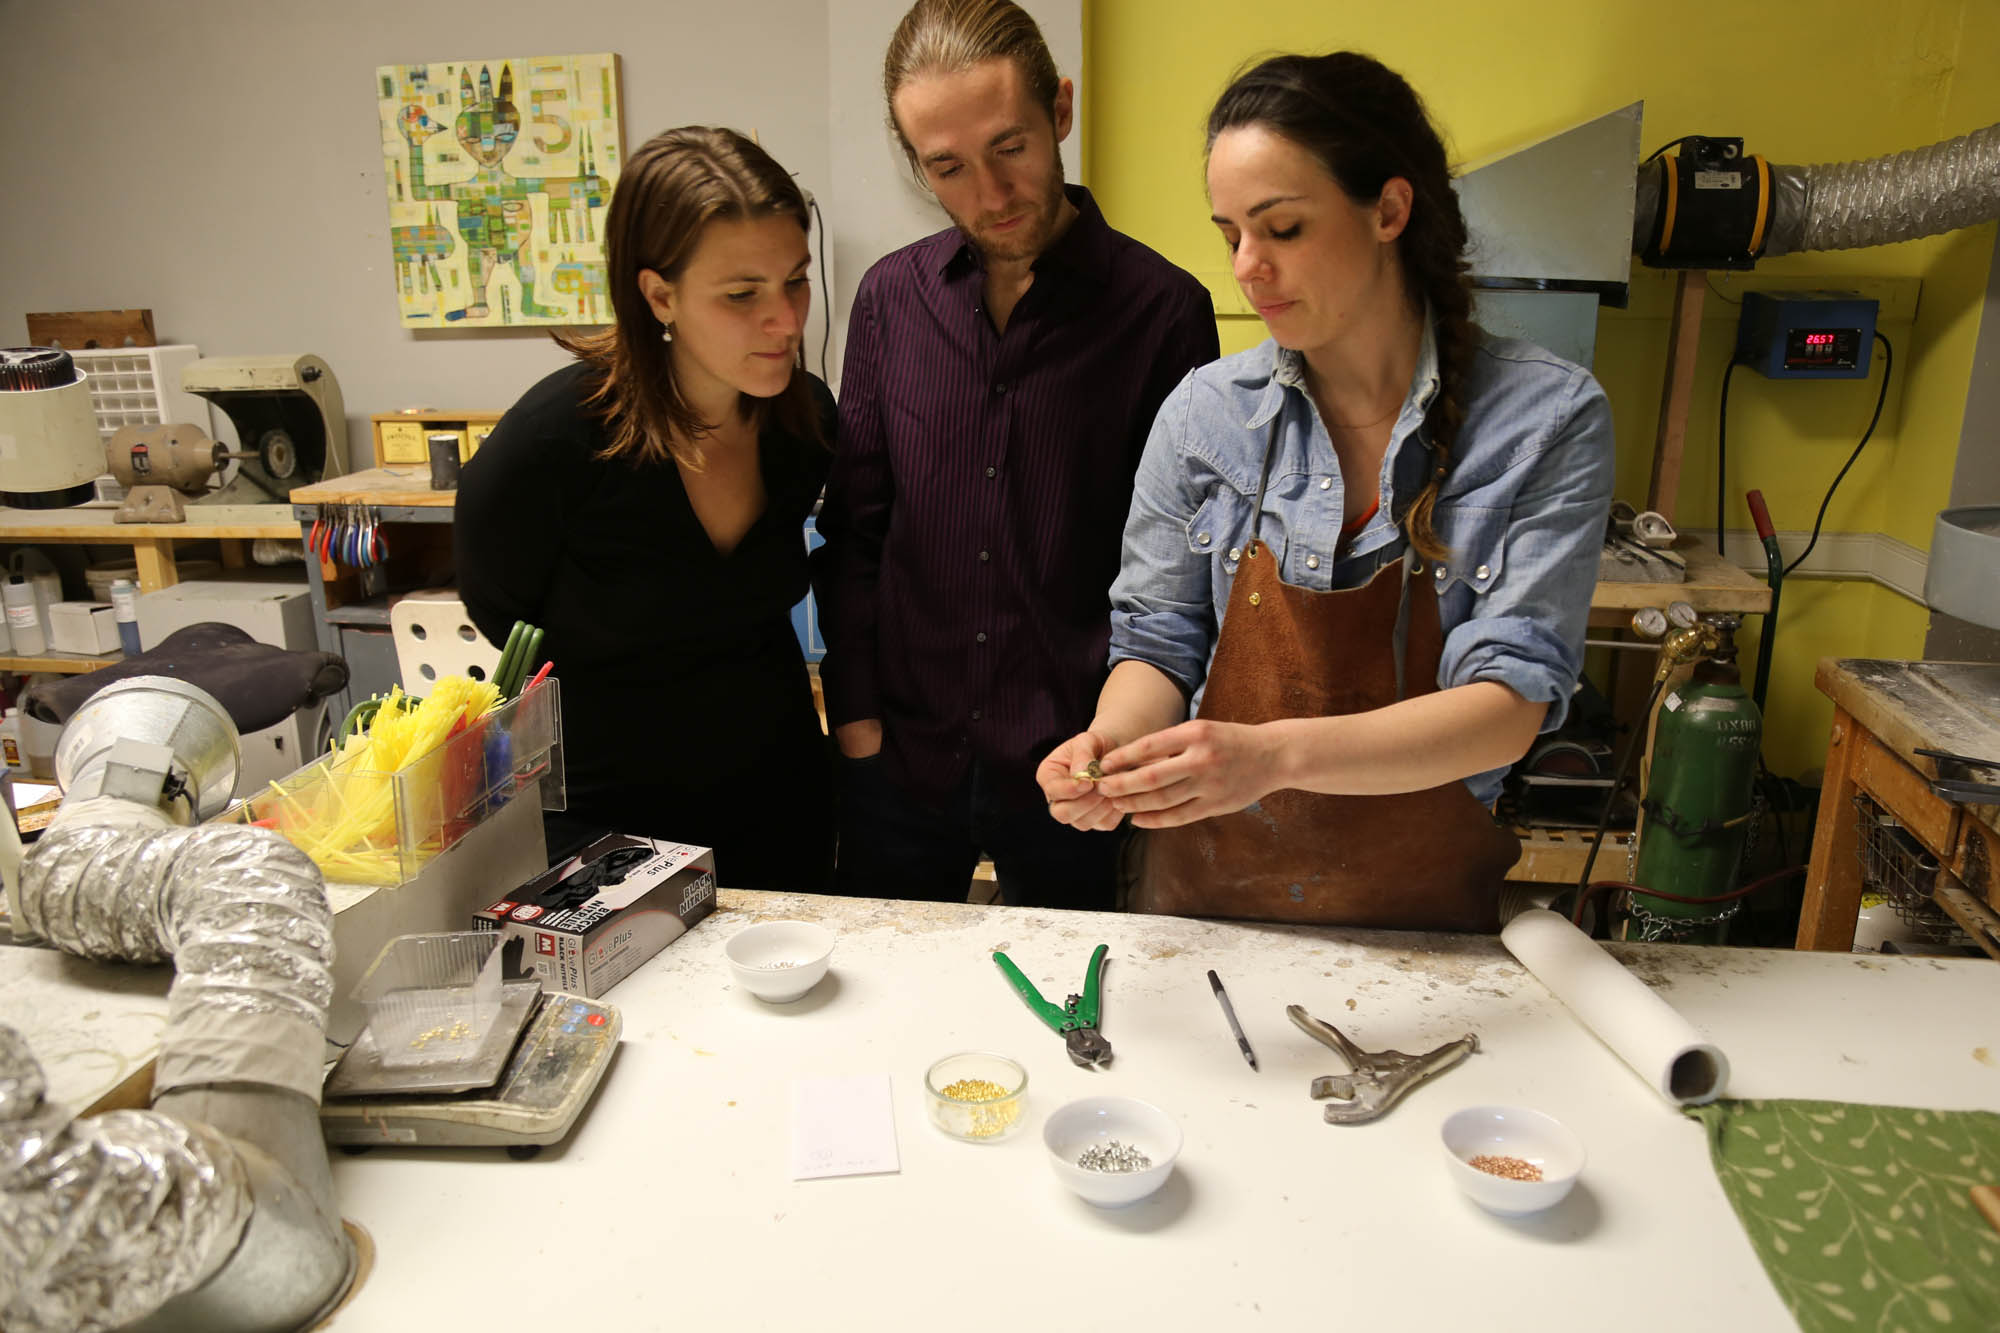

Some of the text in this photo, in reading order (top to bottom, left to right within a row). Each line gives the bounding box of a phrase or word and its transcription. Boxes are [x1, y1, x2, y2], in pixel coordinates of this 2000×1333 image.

[530, 89, 572, 153] 5
[680, 884, 712, 916] NITRILE
[684, 872, 712, 899] BLACK
[558, 900, 605, 930] NITRILE
[572, 907, 613, 932] BLACK
[560, 963, 568, 991] NITRILE
